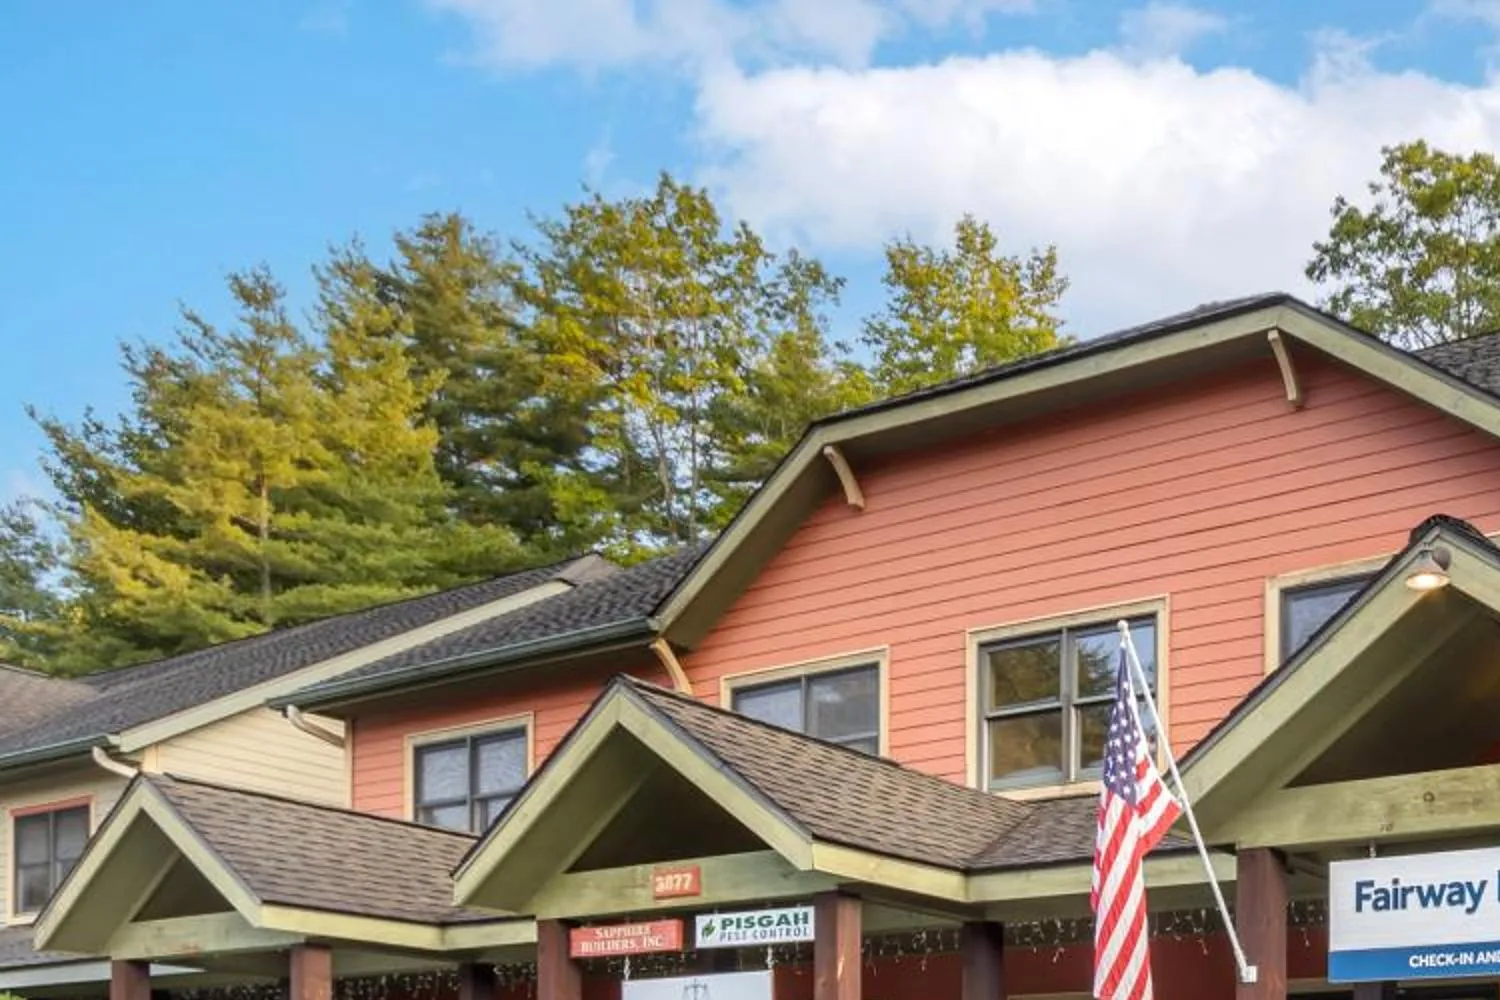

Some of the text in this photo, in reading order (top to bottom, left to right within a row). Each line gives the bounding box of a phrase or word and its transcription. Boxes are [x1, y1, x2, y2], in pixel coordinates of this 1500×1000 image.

[1354, 877, 1488, 915] Fairway
[721, 911, 809, 931] PISGAH
[720, 927, 808, 942] PEST CONTROL
[1408, 952, 1475, 968] CHECK-IN
